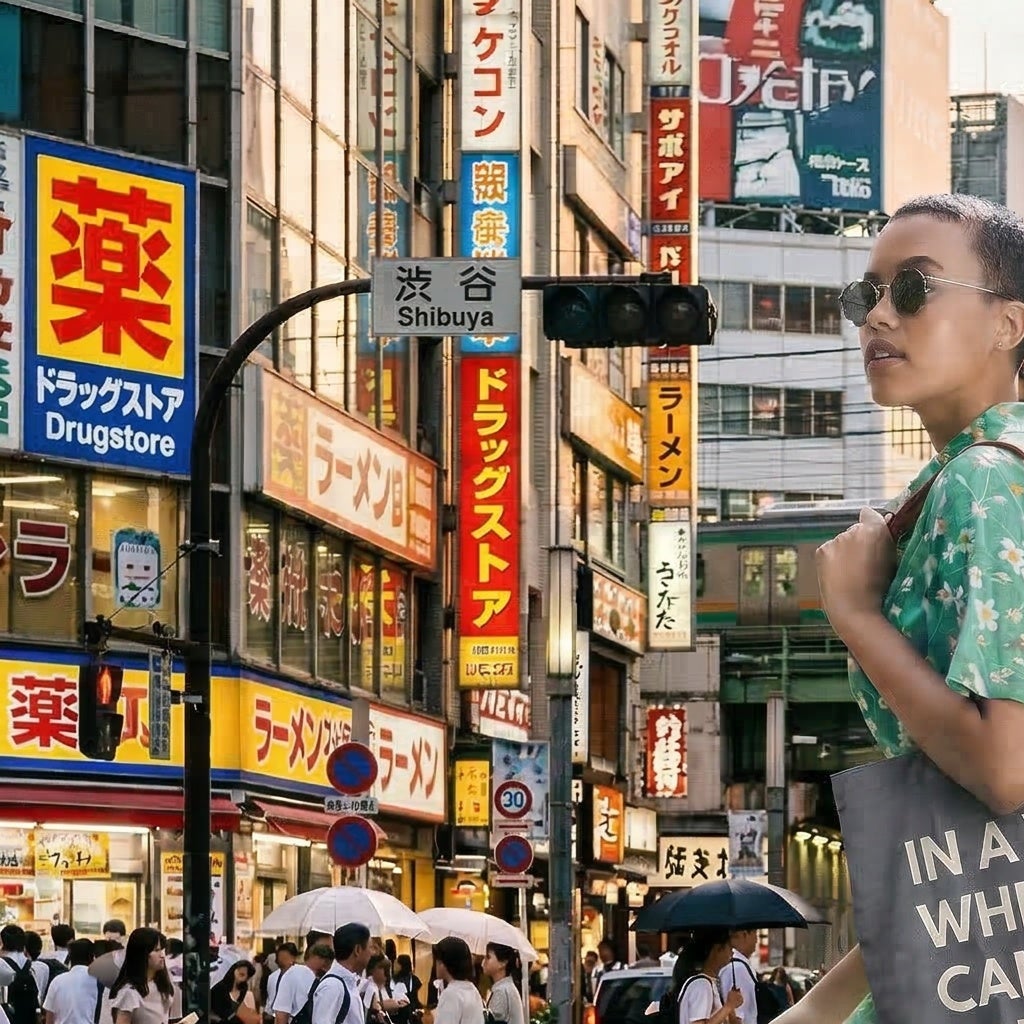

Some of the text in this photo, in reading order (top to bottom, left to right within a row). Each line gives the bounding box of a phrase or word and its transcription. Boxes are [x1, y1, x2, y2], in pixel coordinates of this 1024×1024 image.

[51, 176, 172, 360] 薬
[395, 266, 497, 302] 渋谷
[398, 306, 494, 331] Shibuya
[37, 366, 184, 422] ドラッグストア
[46, 411, 175, 457] Drugstore
[658, 387, 682, 487] ラーメン
[471, 368, 511, 628] ドラッグストア
[380, 728, 438, 800] ラーメン
[503, 791, 524, 808] 30
[905, 830, 963, 885] IN
[979, 821, 1019, 870] A
